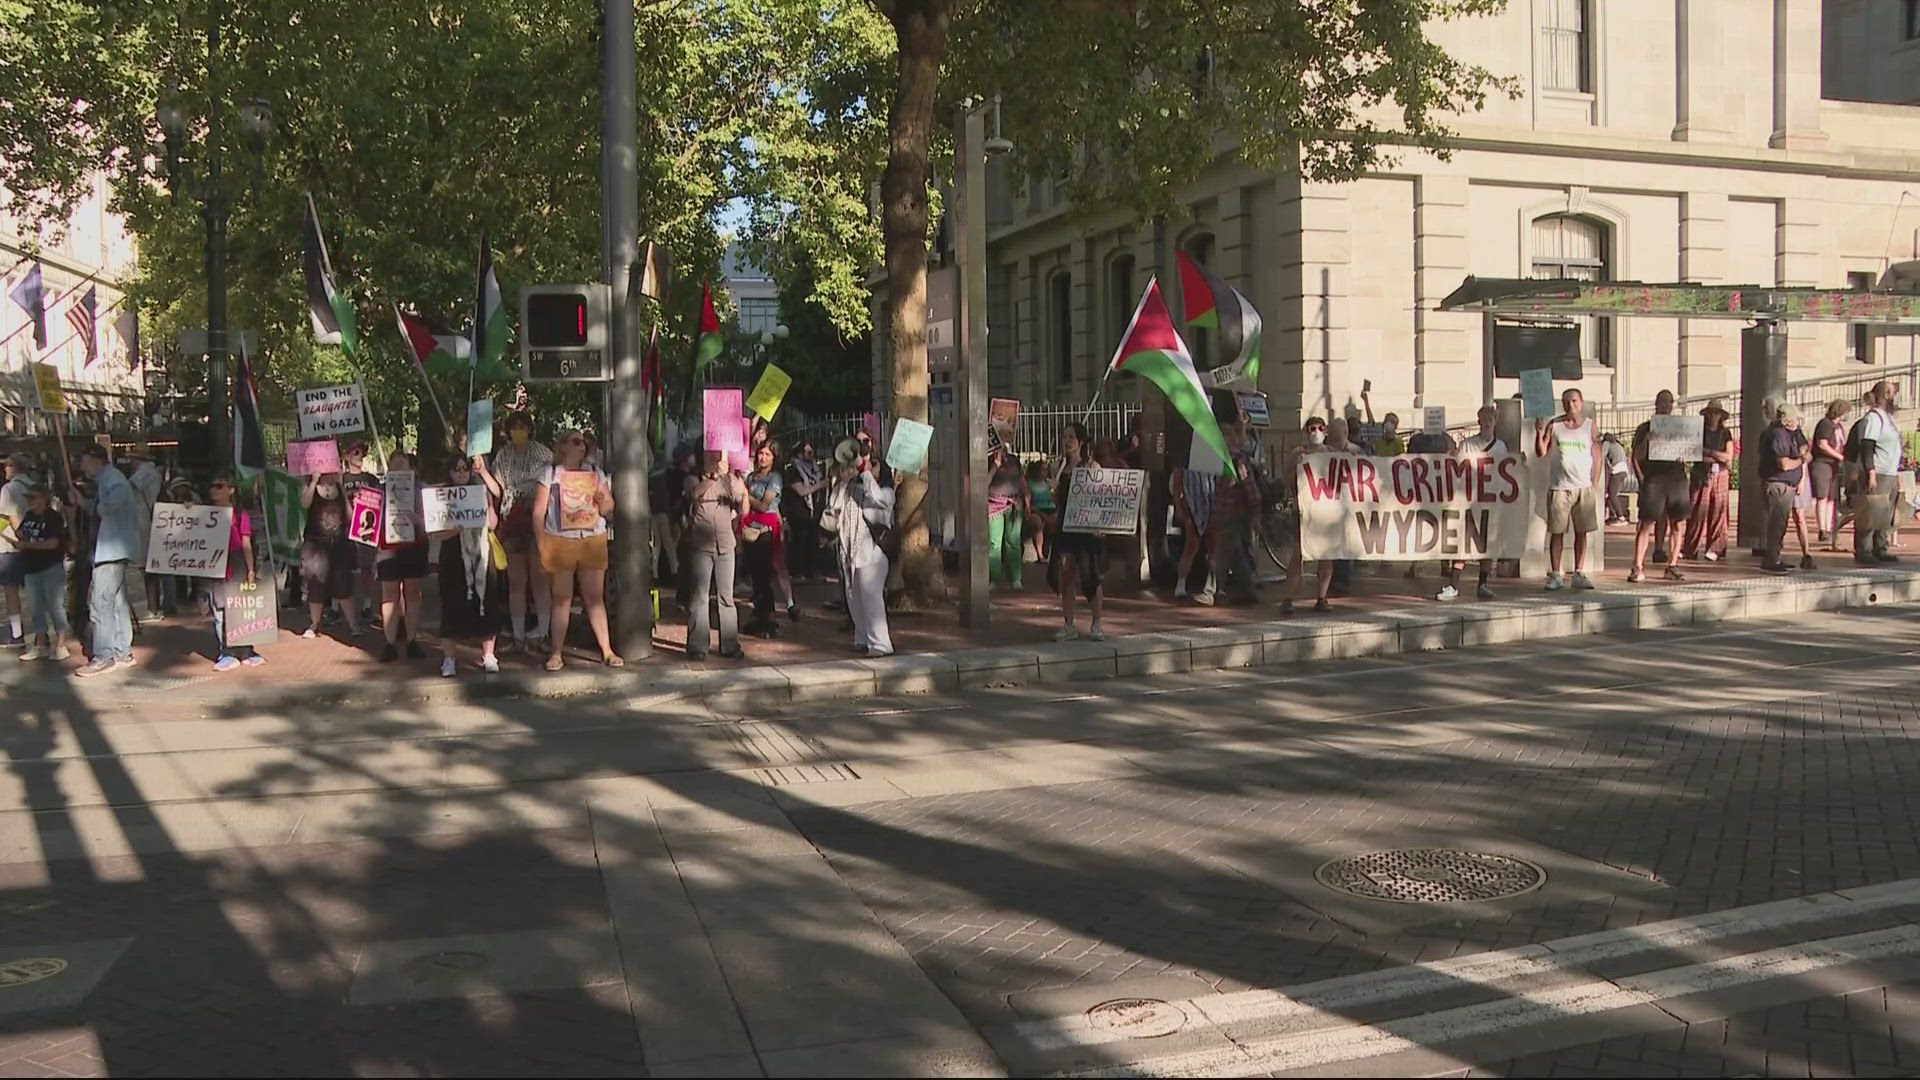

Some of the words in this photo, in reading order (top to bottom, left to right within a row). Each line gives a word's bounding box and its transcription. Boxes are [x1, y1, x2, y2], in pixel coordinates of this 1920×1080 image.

[532, 352, 544, 361] SW
[588, 351, 599, 361] AV
[560, 359, 577, 377] 6th
[305, 391, 327, 402] END
[332, 387, 353, 398] THE
[303, 398, 358, 416] SLAUGHTER
[313, 421, 326, 432] IN
[329, 417, 361, 429] GAZA
[1075, 469, 1104, 484] END
[1111, 470, 1139, 487] THE
[1303, 456, 1380, 503] WAR
[436, 487, 468, 501] END
[1071, 483, 1138, 498] OCCUPATION
[1090, 496, 1136, 510] PALESTINE
[156, 510, 200, 530] Stage
[205, 511, 220, 528] 5
[427, 508, 487, 523] STARVATION
[1355, 508, 1490, 555] WYDEN
[162, 533, 208, 550] famine
[168, 549, 224, 571] Gaza!!
[239, 582, 257, 593] NO
[226, 595, 264, 609] PRIDE
[243, 608, 257, 620] IN
